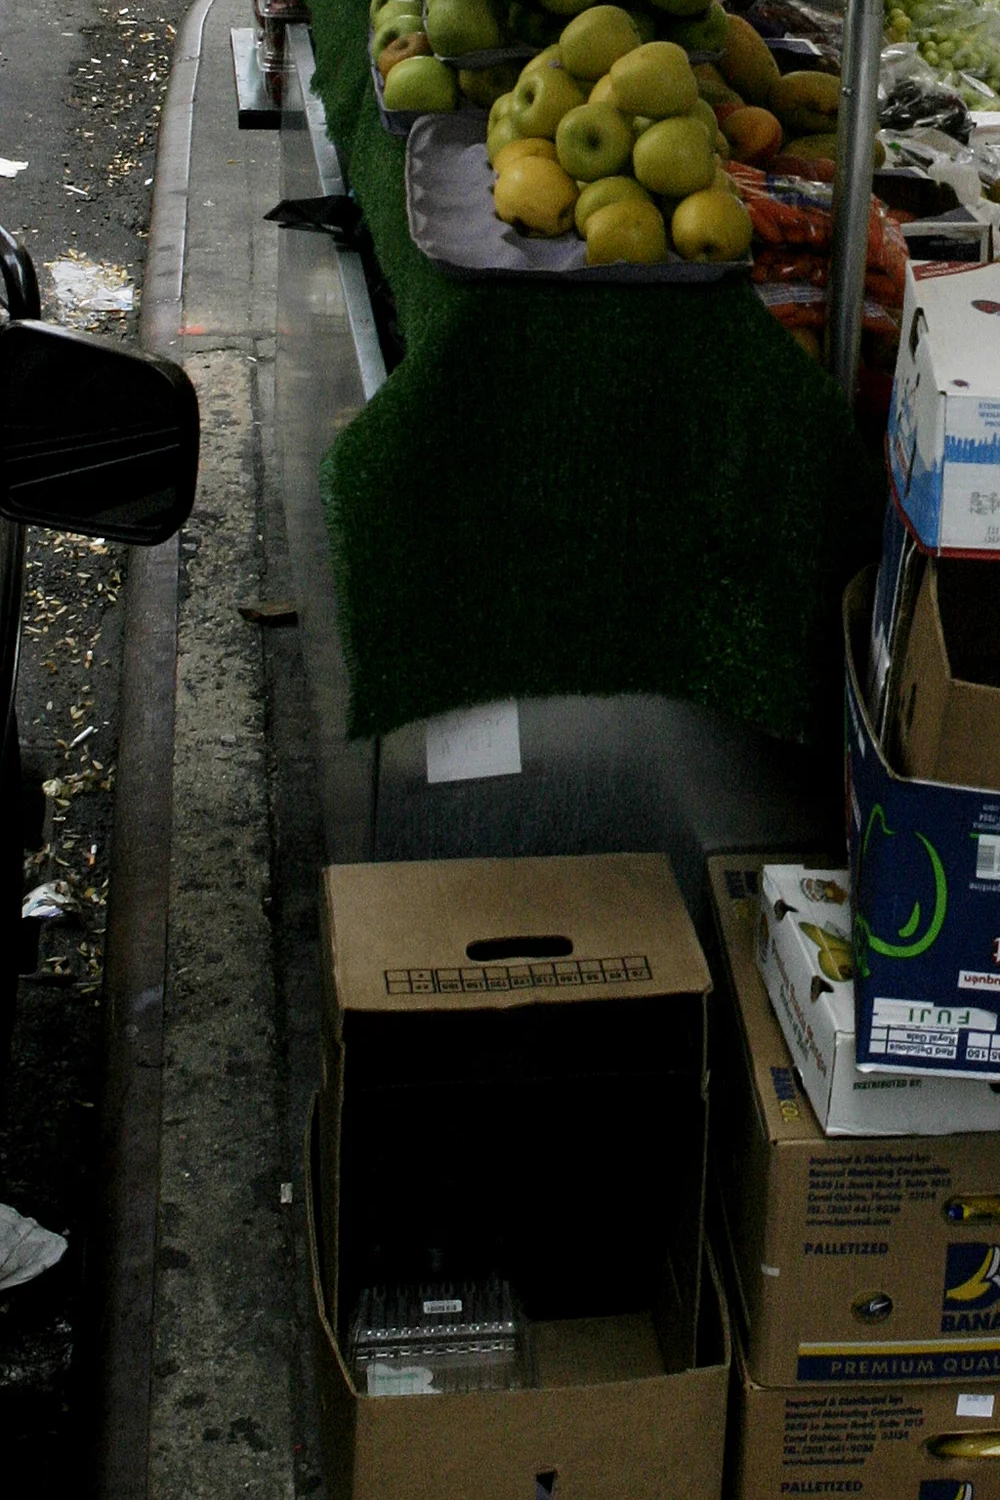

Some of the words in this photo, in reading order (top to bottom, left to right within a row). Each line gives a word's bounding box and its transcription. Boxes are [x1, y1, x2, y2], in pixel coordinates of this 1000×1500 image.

[909, 1008, 970, 1025] FUJI
[929, 1033, 956, 1045] Royal
[935, 1046, 954, 1056] Red
[803, 1241, 890, 1257] PALLETIZED
[830, 1359, 935, 1376] PREMIUM
[780, 1479, 863, 1492] PALLETIZED
